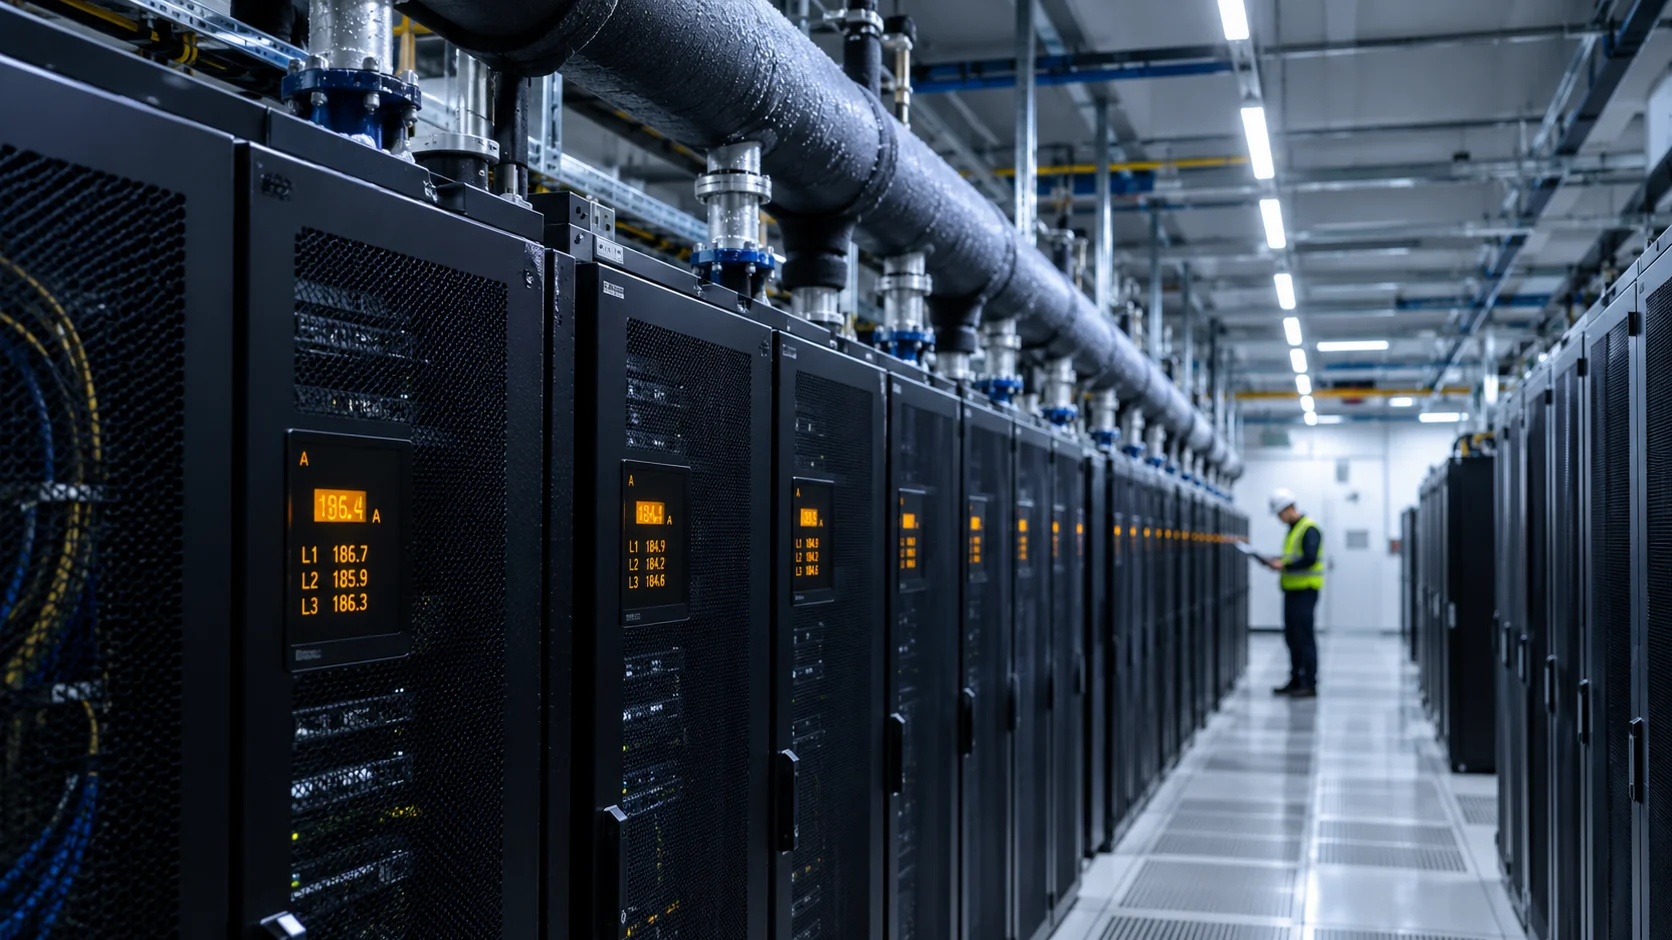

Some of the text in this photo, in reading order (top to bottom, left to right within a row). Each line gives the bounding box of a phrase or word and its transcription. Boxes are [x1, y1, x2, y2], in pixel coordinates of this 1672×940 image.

[300, 451, 309, 466] A
[628, 474, 635, 487] A
[372, 508, 381, 523] A
[666, 515, 673, 526] A
[629, 539, 666, 553] L1 184.9
[302, 545, 368, 564] L1 186.7
[629, 557, 665, 571] L2 184.2
[302, 569, 368, 590] L2 185.9
[628, 574, 665, 589] L3 184.6
[302, 593, 368, 616] L3 186.3
